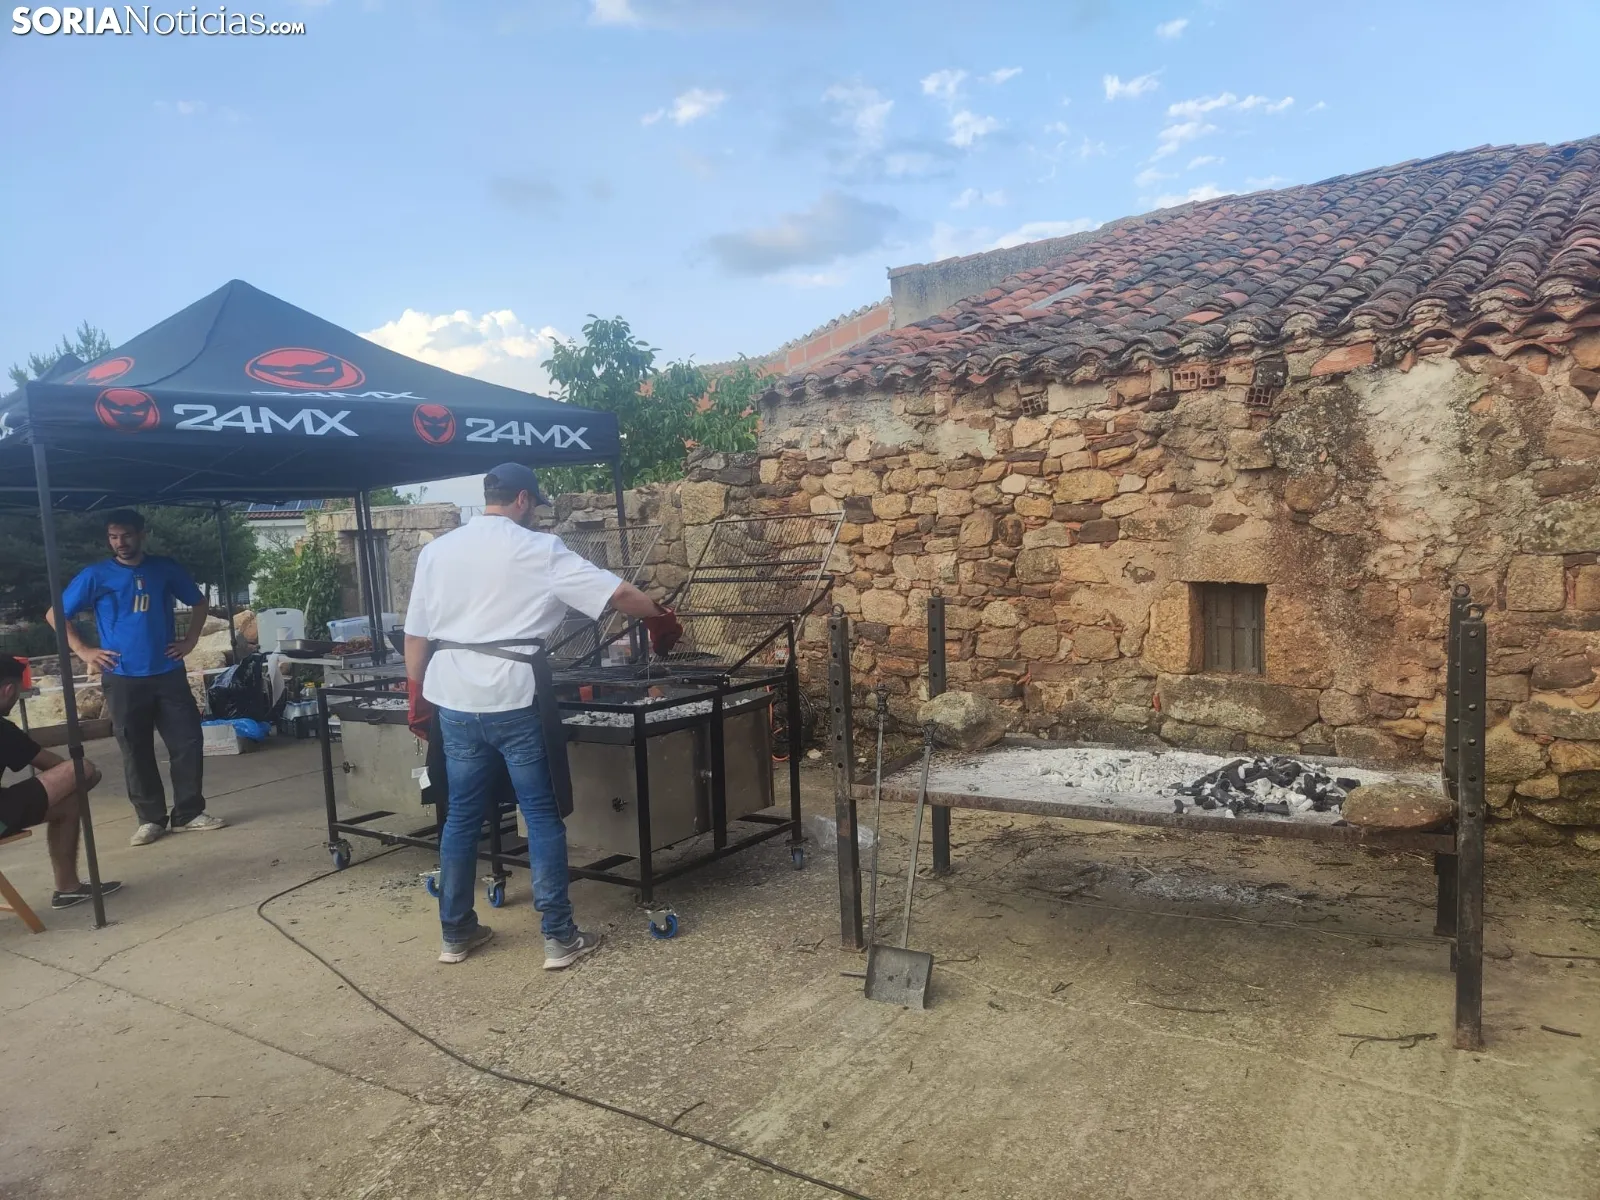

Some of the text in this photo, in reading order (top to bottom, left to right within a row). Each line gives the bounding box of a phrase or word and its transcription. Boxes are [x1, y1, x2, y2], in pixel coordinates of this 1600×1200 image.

[173, 404, 359, 436] 24MX
[465, 417, 592, 450] 24MX
[132, 594, 150, 613] 10
